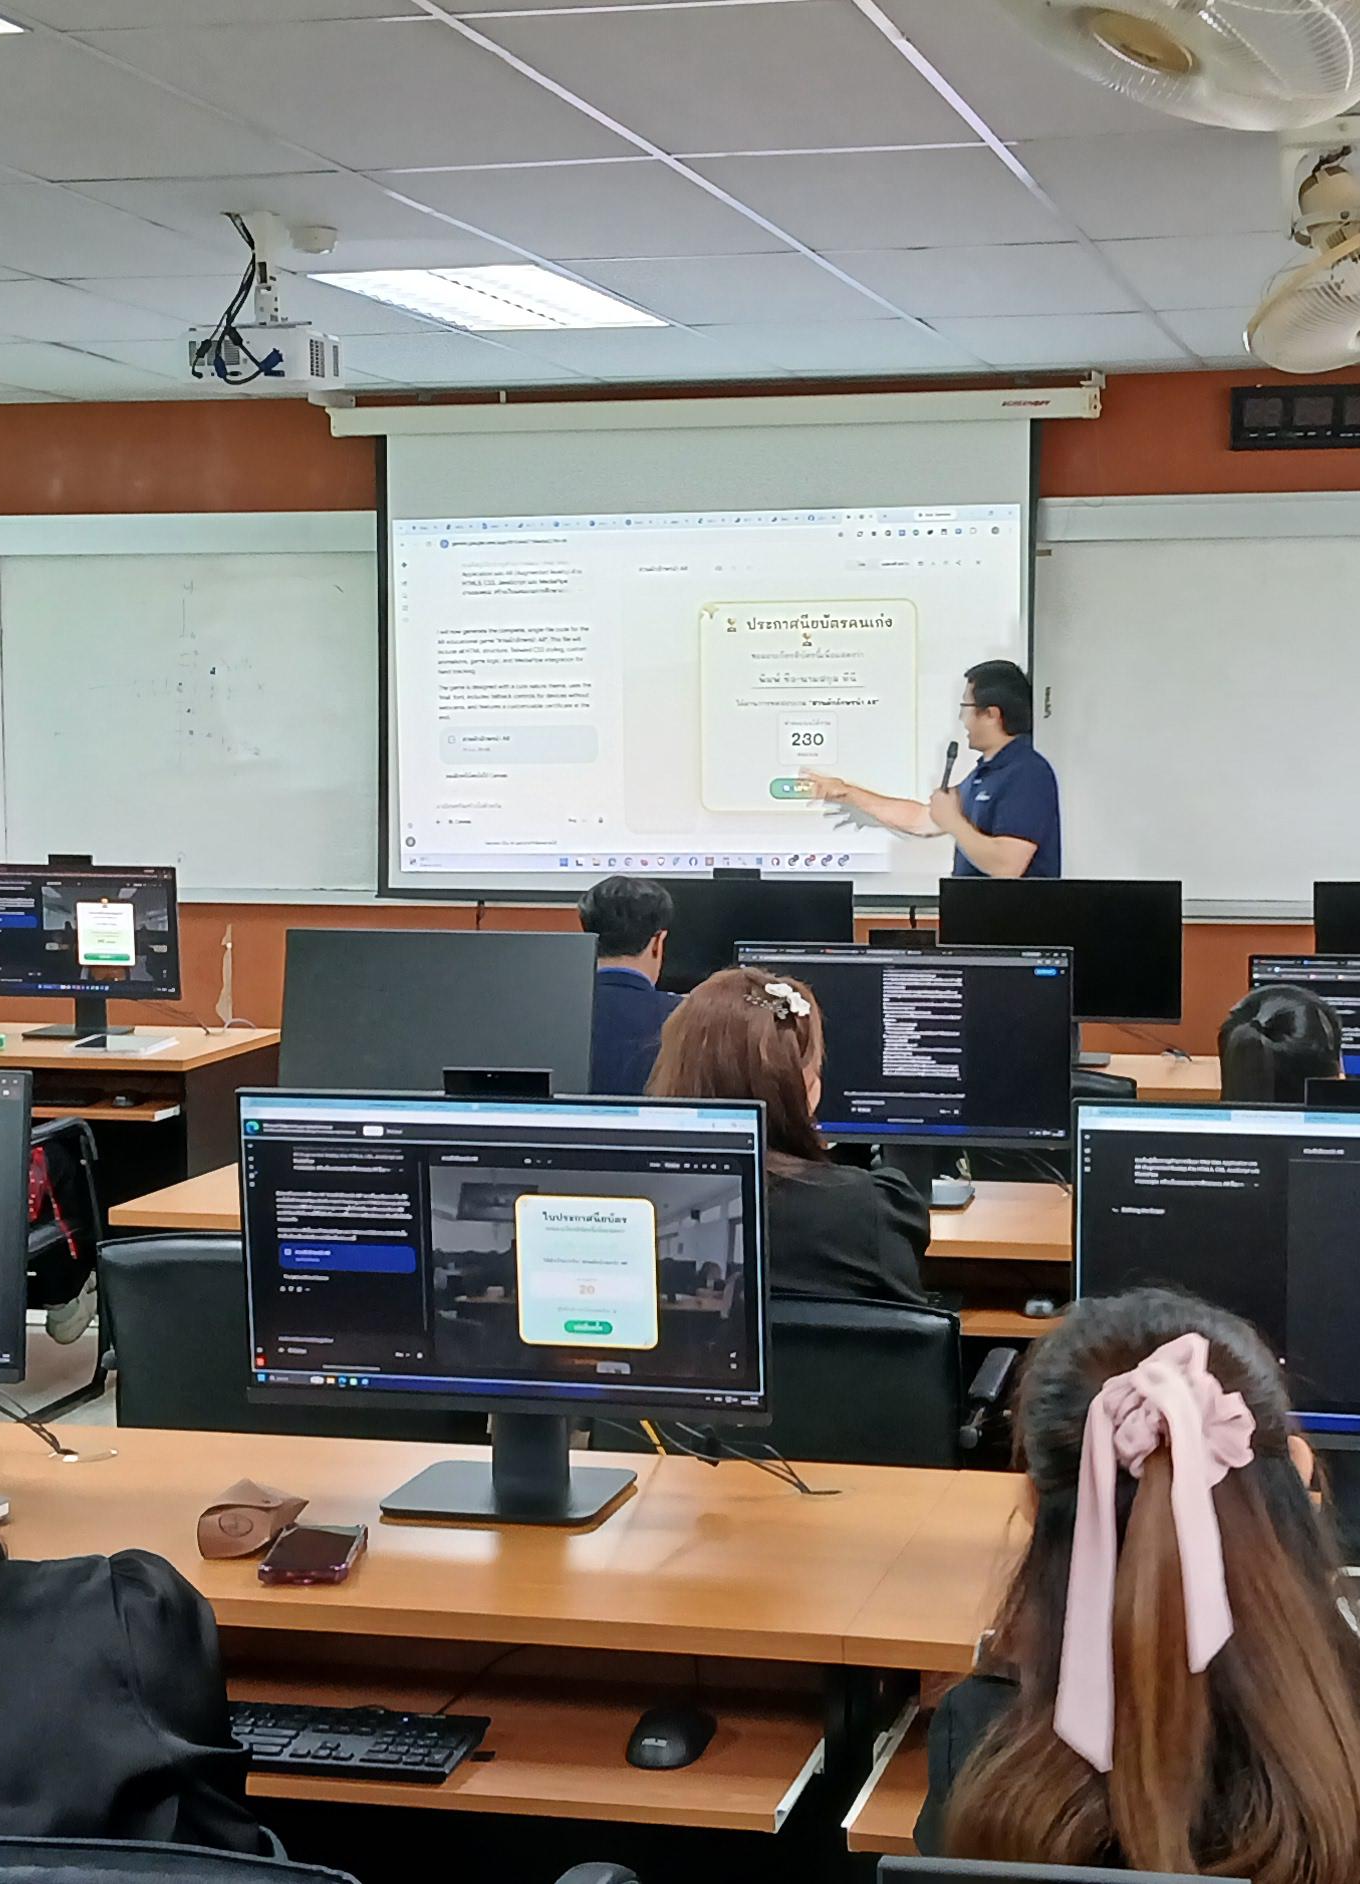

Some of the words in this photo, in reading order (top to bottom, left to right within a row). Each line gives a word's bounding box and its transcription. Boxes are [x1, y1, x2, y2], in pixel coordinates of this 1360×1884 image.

[747, 613, 893, 630] ประกาศนียบัตรคนเก่ง
[792, 733, 824, 746] 230
[579, 1285, 596, 1294] 20
